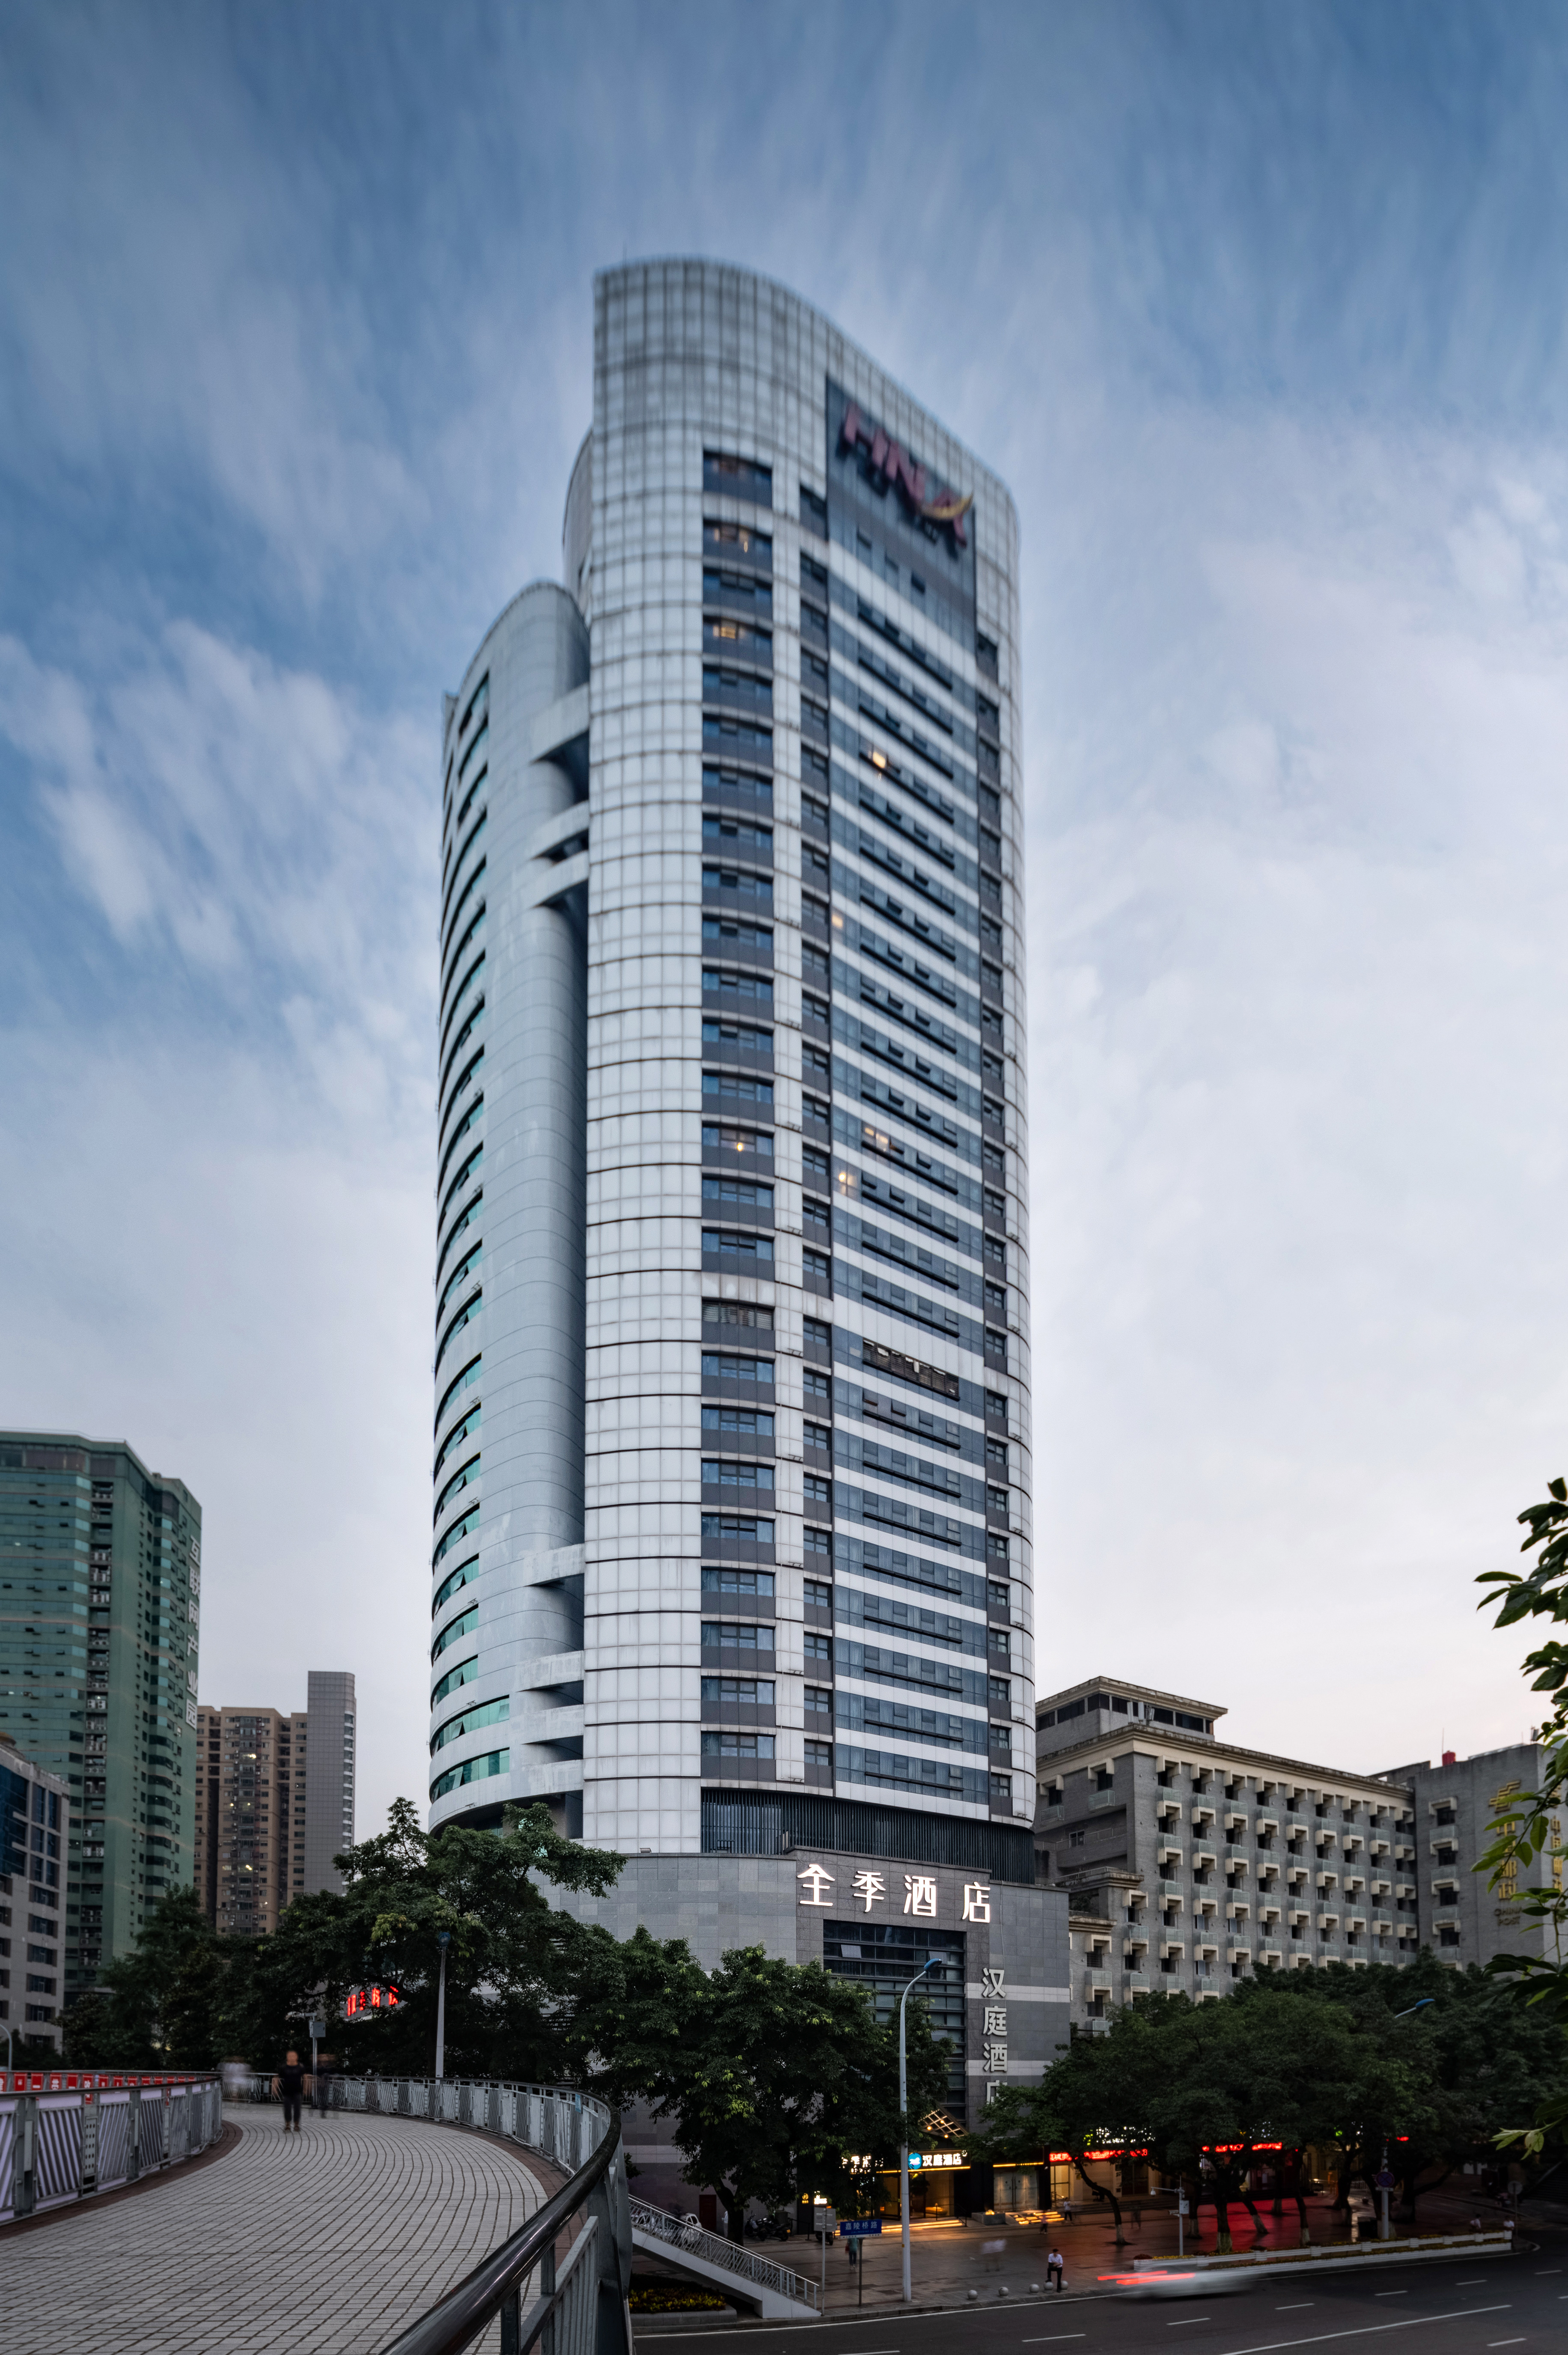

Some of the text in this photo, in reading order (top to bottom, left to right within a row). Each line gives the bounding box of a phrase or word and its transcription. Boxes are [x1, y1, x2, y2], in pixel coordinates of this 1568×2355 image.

[796, 1863, 991, 1924] 全季酒店
[922, 2152, 962, 2167] 汉庭酒店
[845, 2221, 878, 2230] 嘉陵桥路
